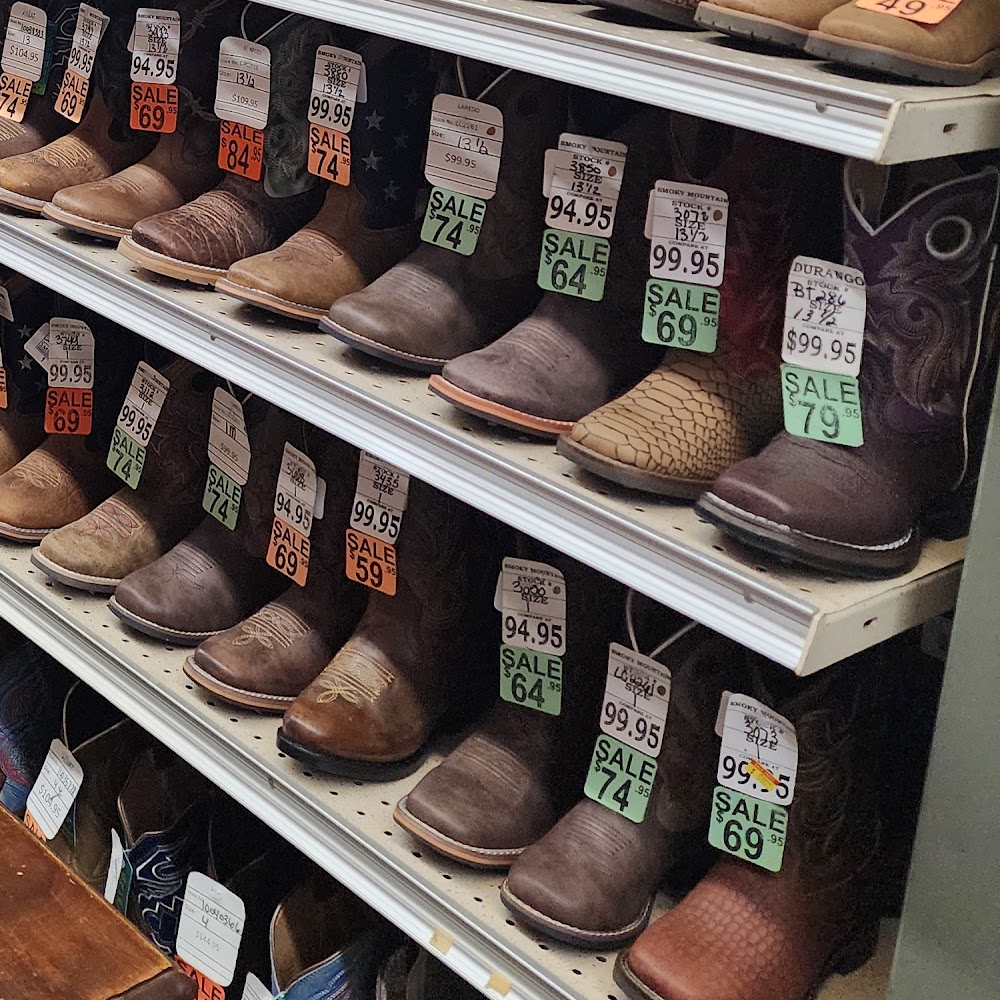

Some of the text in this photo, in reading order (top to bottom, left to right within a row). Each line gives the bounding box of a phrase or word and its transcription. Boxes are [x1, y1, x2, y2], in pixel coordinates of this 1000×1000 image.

[10, 45, 39, 62] $104.95
[70, 47, 94, 73] 99.95
[133, 56, 175, 79] 94.95
[0, 75, 31, 98] SALE
[63, 72, 87, 97] SALE
[132, 85, 177, 105] SALE
[232, 93, 258, 109] $109.95
[311, 96, 351, 127] 99.95
[221, 121, 263, 145] SALE
[310, 127, 350, 156] SALE
[431, 129, 445, 138] Size:
[445, 153, 477, 169] $99.95
[573, 154, 603, 165] STOCK
[573, 171, 603, 184] SIZE
[658, 187, 685, 196] SMOKY
[431, 191, 485, 224] SALE
[549, 195, 613, 231] 94.95
[671, 200, 704, 210] STOCK
[674, 218, 706, 231] SIZE
[545, 233, 608, 265] SALE
[669, 240, 697, 248] COMPARE
[652, 245, 720, 278] 99.95
[793, 262, 865, 286] DURANGO
[807, 279, 840, 292] STOCK
[647, 284, 719, 315] SALE
[810, 300, 843, 315] SIZE
[802, 323, 835, 334] COMPARE
[787, 328, 857, 365] $99.95
[50, 363, 93, 384] 99.95
[47, 390, 92, 407] SALE
[784, 371, 857, 405] SALE
[119, 405, 153, 442] 99.95
[113, 429, 146, 465] SALE
[209, 468, 242, 502] SALE
[373, 483, 394, 495] SIZE
[277, 492, 310, 530] 94.95
[353, 501, 400, 538] 99.95
[273, 520, 310, 559] SALE
[347, 533, 396, 566] SALE
[521, 593, 548, 605] SIZE
[504, 615, 563, 649] 94.95
[501, 649, 561, 681] SALE
[604, 701, 660, 749] 99.95
[596, 739, 657, 786] SALE
[37, 784, 62, 818] $104.95
[715, 791, 786, 834] SALE
